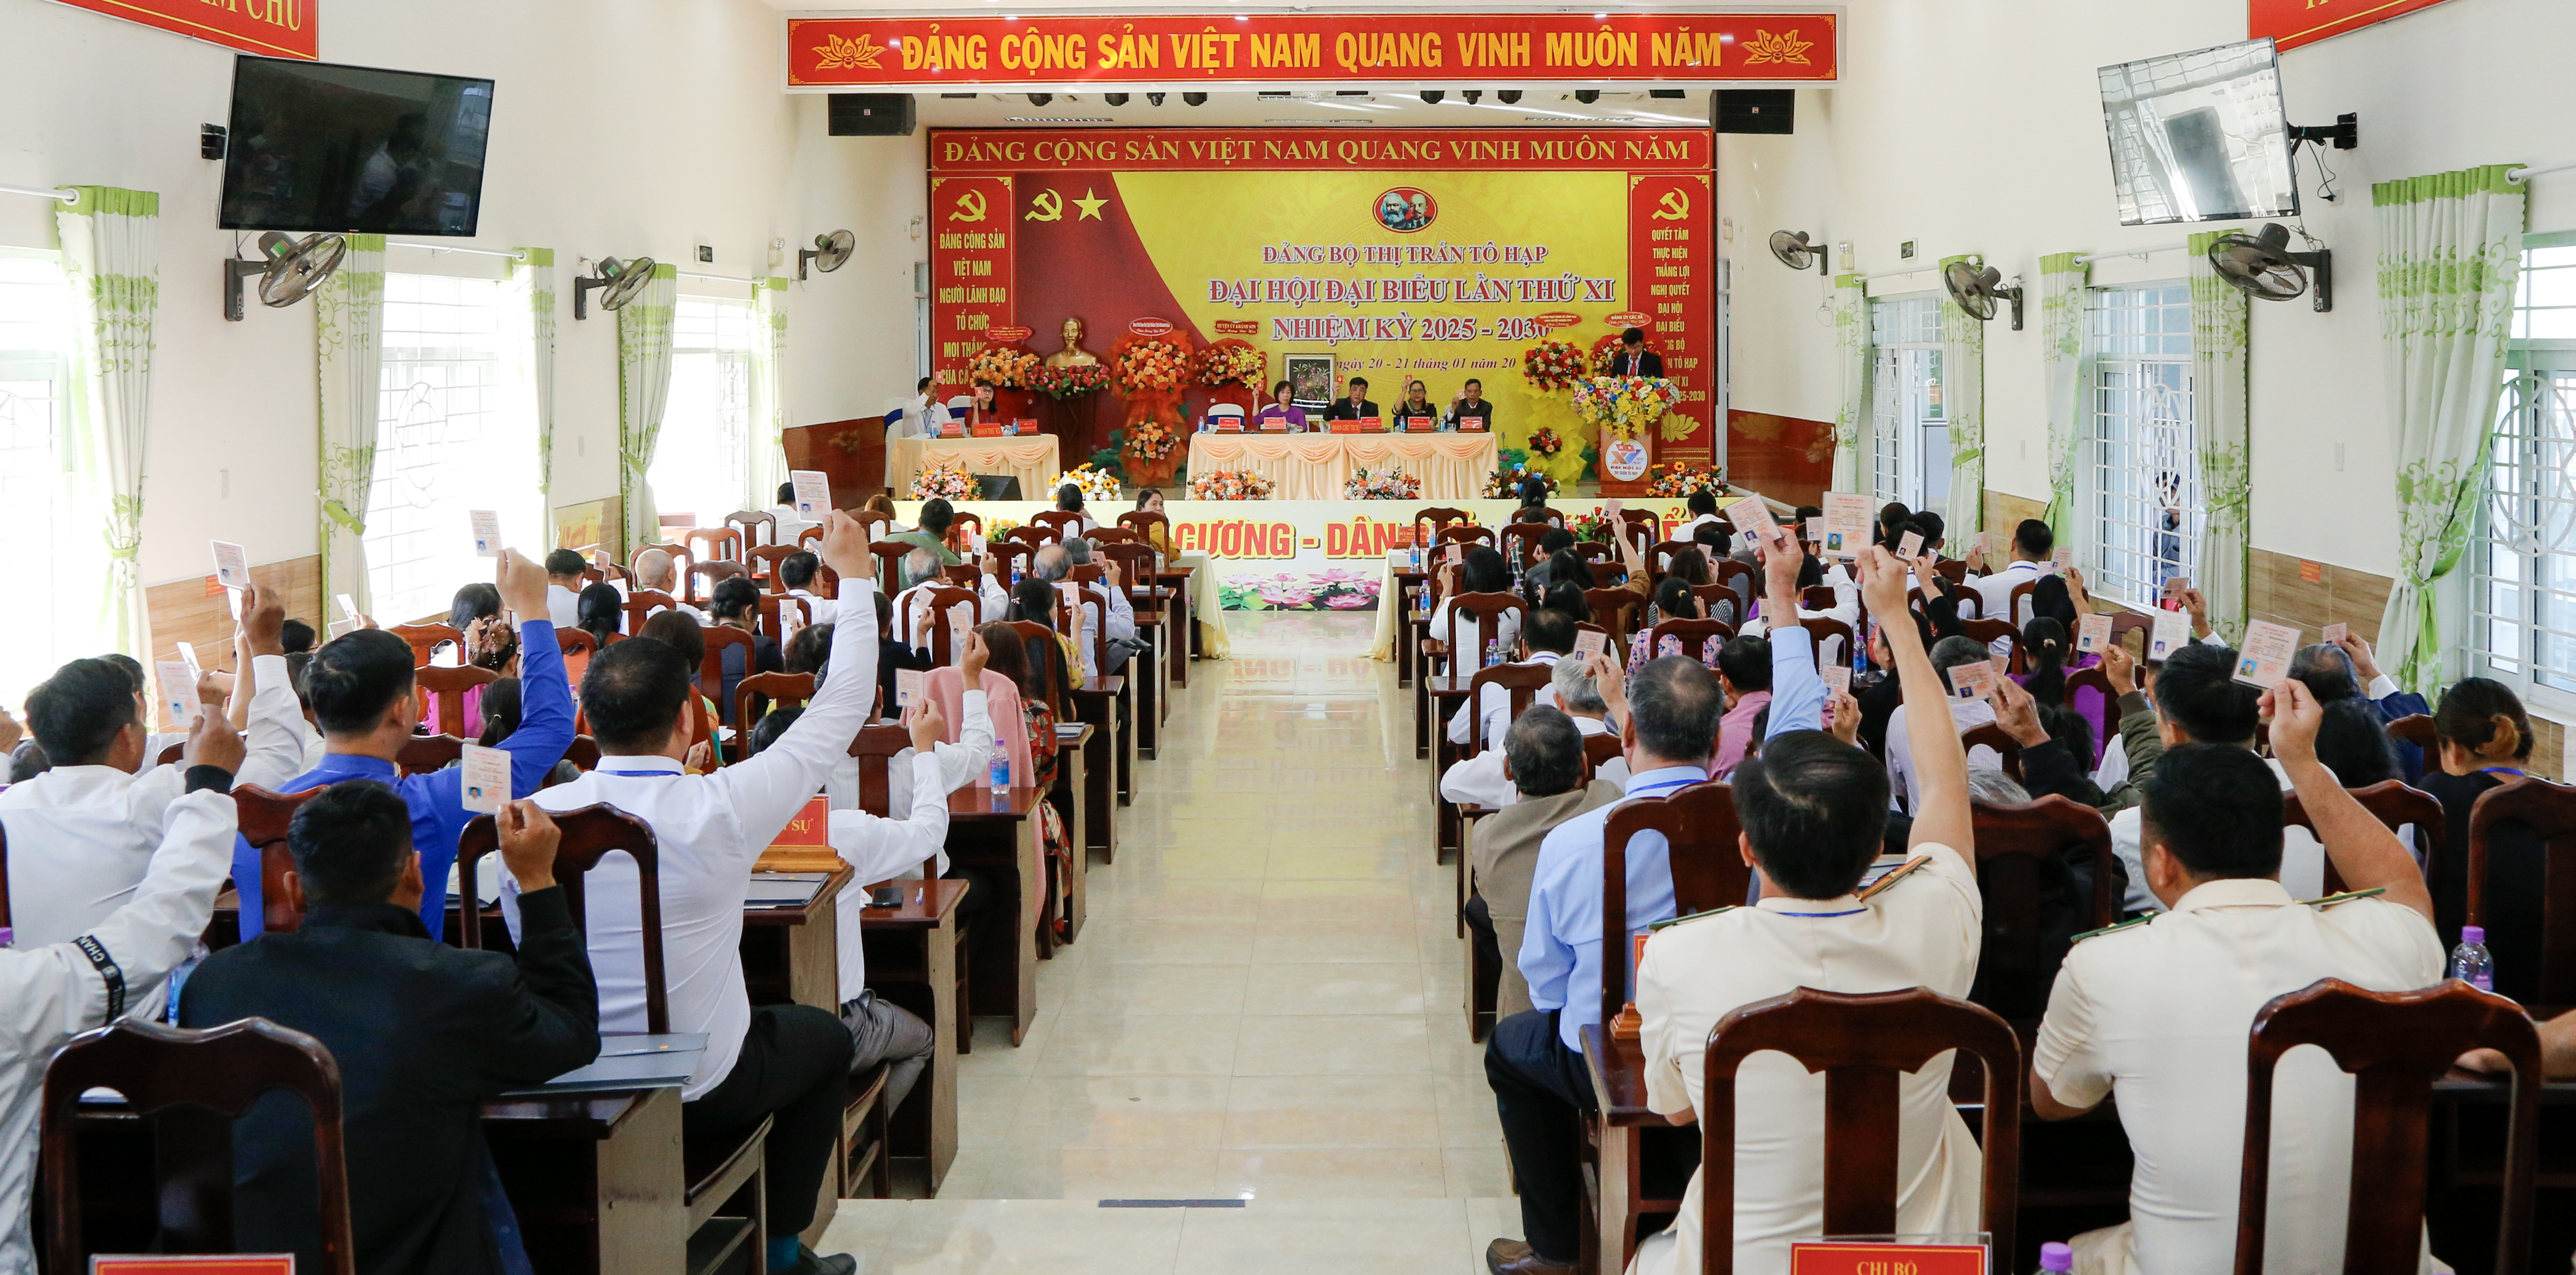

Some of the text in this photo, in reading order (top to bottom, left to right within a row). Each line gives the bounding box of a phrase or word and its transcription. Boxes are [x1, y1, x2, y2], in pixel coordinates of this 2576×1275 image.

[901, 23, 1721, 75] ĐẢNG CỘNG SẢN VIỆT NAM QUANG VINH MUÔN NĂM
[944, 135, 1690, 166] ĐẢNG CỘNG SẢN VIỆT NAM QUANG VINH MUÔN NĂM
[940, 228, 1005, 252] ĐẢNG CỘNG SẢN
[1652, 226, 1689, 241] QUYẾT TÂM
[1261, 241, 1548, 267] ĐẢNG BỘ THỊ TRẤN TÔ HẠP
[1653, 246, 1687, 261] THỰC HIỆN
[953, 257, 991, 280] VIỆT NAM
[1655, 262, 1690, 279] THẮNG LỢI
[940, 284, 1006, 306] NGƯỜI LÃNH ĐẠO
[1207, 272, 1615, 308] ĐẠI HỘI ĐẠI BIỂU LẦN THỨ XI
[1651, 281, 1690, 298] NGHỊ QUYẾT
[1658, 301, 1682, 316] ĐẠI HỘI
[956, 309, 990, 330] TỔ CHỨC
[1270, 313, 1369, 347] NHIỆM
[1372, 310, 1416, 341] KỲ
[1420, 317, 1477, 341] 2025
[1656, 317, 1684, 334] ĐẠI BIỂU
[944, 342, 959, 361] MỌI
[1676, 338, 1685, 352] BỘ
[1336, 358, 1364, 371] ngày
[1369, 359, 1382, 368] 20
[1395, 358, 1408, 368] 21
[1414, 358, 1448, 370] tháng
[1453, 358, 1465, 368] 01
[1471, 359, 1497, 368] năm
[1502, 358, 1516, 368] 20
[1674, 356, 1682, 368] TÔ
[1684, 358, 1697, 370] HẠP
[1682, 377, 1688, 386] XI
[1176, 521, 1289, 555] CƯƠNG
[1328, 516, 1396, 554] DÂN
[791, 818, 813, 833] SỰ
